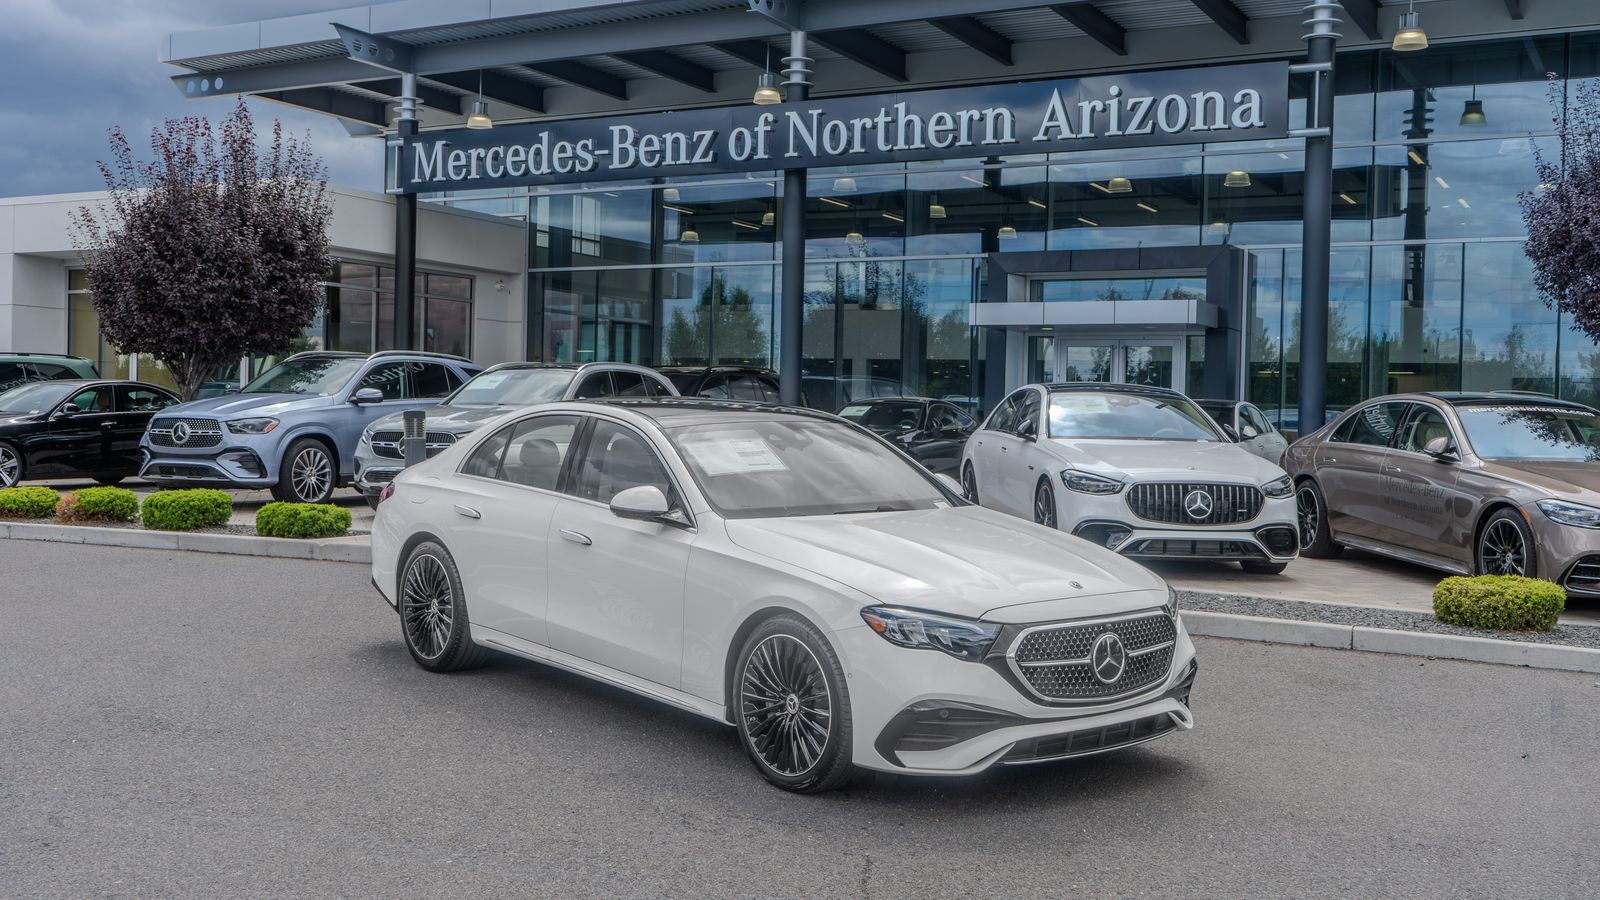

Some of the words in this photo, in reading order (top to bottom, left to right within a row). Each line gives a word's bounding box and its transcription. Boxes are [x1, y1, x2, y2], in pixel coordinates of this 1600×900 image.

[411, 124, 716, 183] Mercedes-Benz
[728, 112, 774, 161] of
[784, 102, 1016, 157] Northern
[1032, 85, 1265, 142] Arizona
[1468, 405, 1596, 417] mercedesarizona.com
